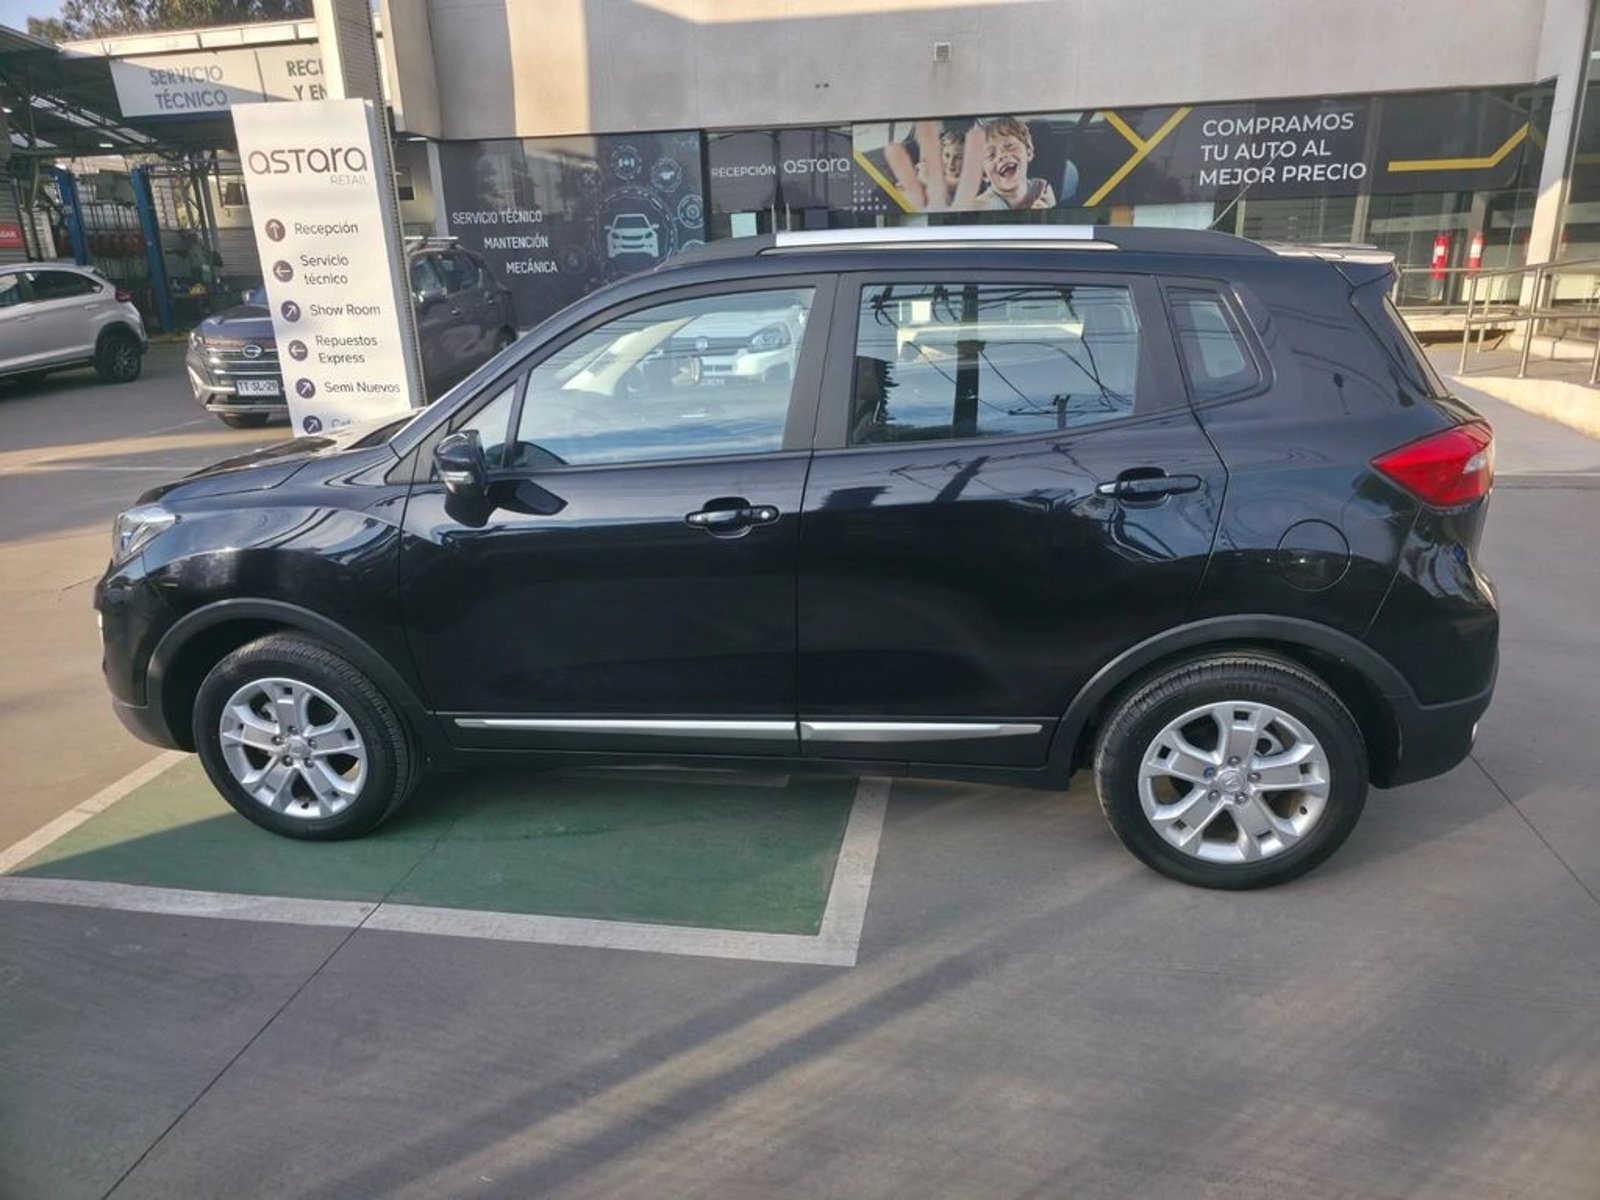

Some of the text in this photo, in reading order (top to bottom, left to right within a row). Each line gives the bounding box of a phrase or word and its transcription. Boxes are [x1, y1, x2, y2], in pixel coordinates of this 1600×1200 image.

[149, 64, 224, 86] SERVICIO
[155, 88, 227, 110] TÉCNICO
[293, 85, 303, 101] Y
[1202, 112, 1355, 137] COMPRAMOS
[1201, 139, 1331, 162] TU AUTO AL
[711, 164, 776, 178] RECEPCIÓN
[1199, 162, 1367, 187] MEJOR PRECIO
[330, 174, 368, 186] RETAIL
[452, 207, 543, 224] SERVICIO TÉCNICO
[294, 221, 359, 236] Recepción
[483, 233, 549, 249] MANTENCIÓN
[300, 254, 349, 267] Servicio
[506, 258, 558, 275] MECÁNICA
[304, 272, 348, 285] técnico
[310, 303, 380, 316] Show Room
[315, 335, 378, 348] Repuestos
[318, 352, 366, 365] Express
[324, 381, 400, 393] Semi Nuevos
